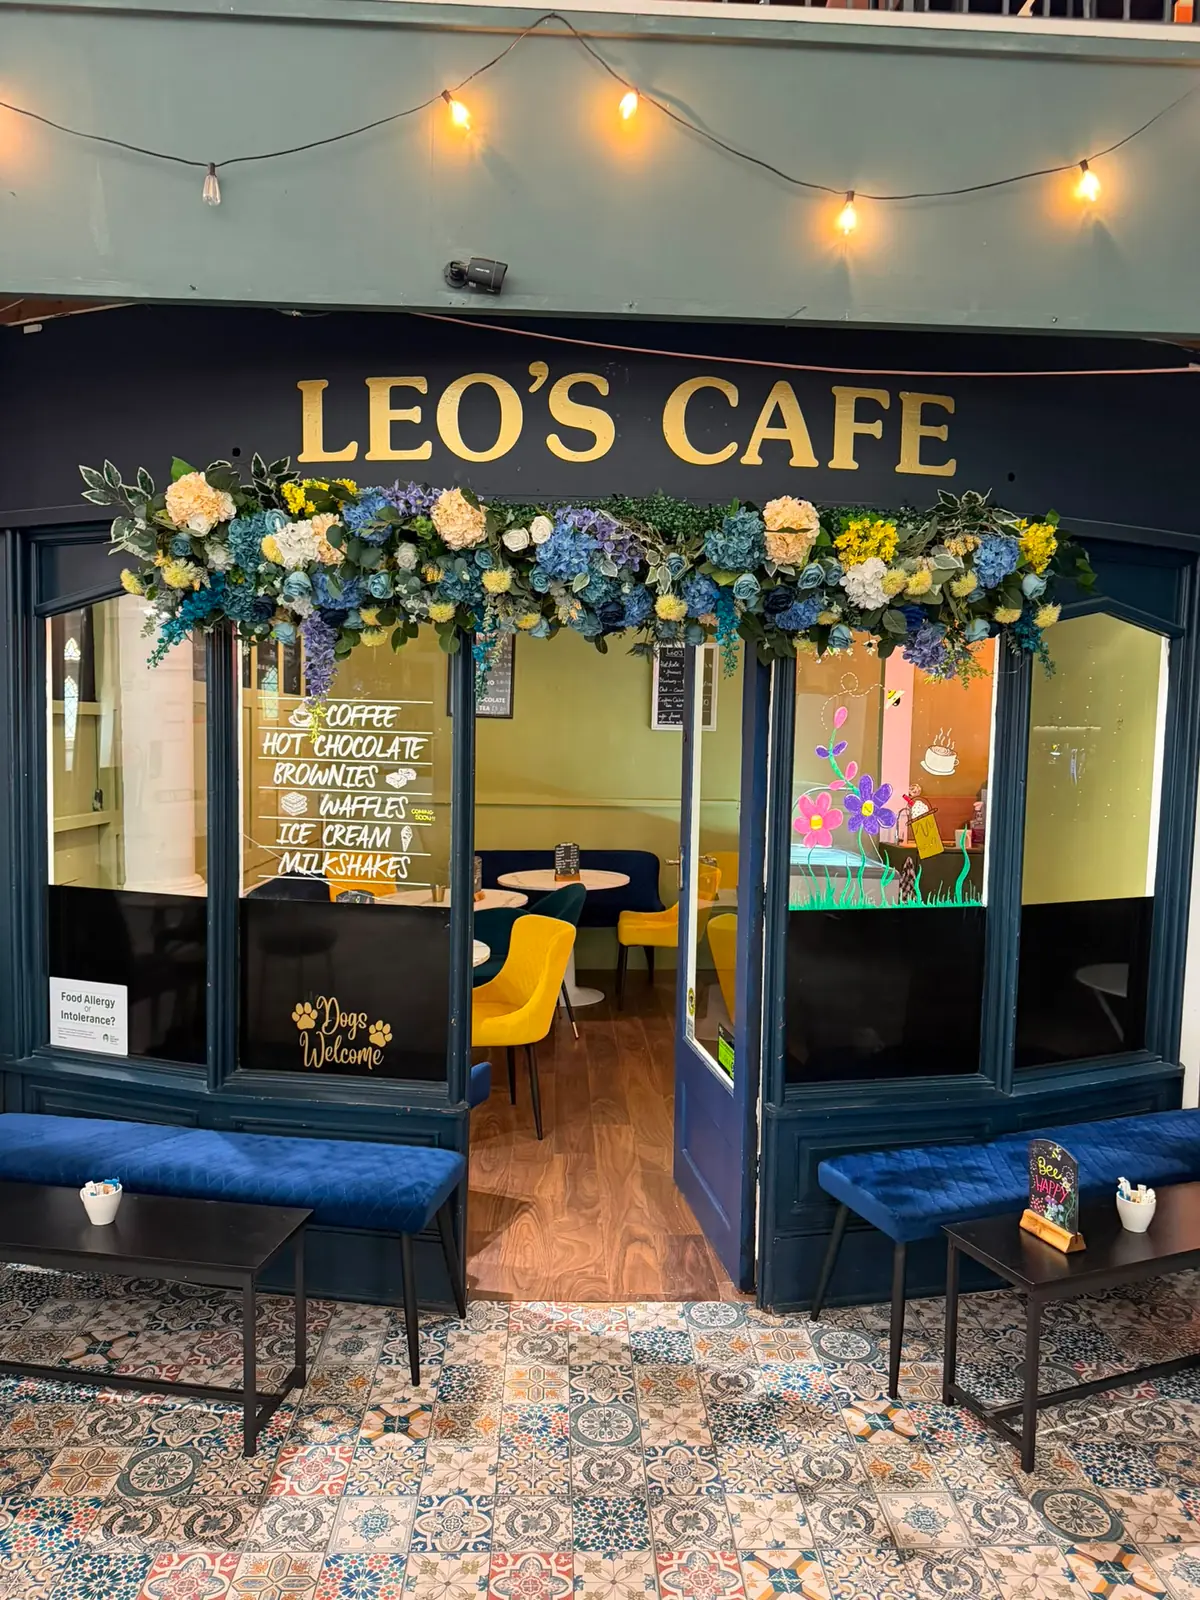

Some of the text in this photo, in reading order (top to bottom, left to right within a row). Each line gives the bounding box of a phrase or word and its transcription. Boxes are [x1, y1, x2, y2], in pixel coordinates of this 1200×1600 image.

[297, 361, 957, 477] LEO'S CAFE
[325, 704, 402, 728] COFFEE
[262, 732, 429, 760] HOT CHOCOLATE
[273, 763, 379, 789] BROWNIES
[319, 793, 409, 819] WAFFLES
[276, 823, 392, 848] ICE CREAM
[278, 852, 411, 879] MILKSHAKES
[61, 992, 116, 1009] Food Allergy
[61, 1010, 116, 1026] Intolerance?
[316, 996, 368, 1040] Dogs
[299, 1031, 384, 1070] Welcome
[1037, 1156, 1063, 1179] Bee
[1034, 1175, 1069, 1204] HAPPY
